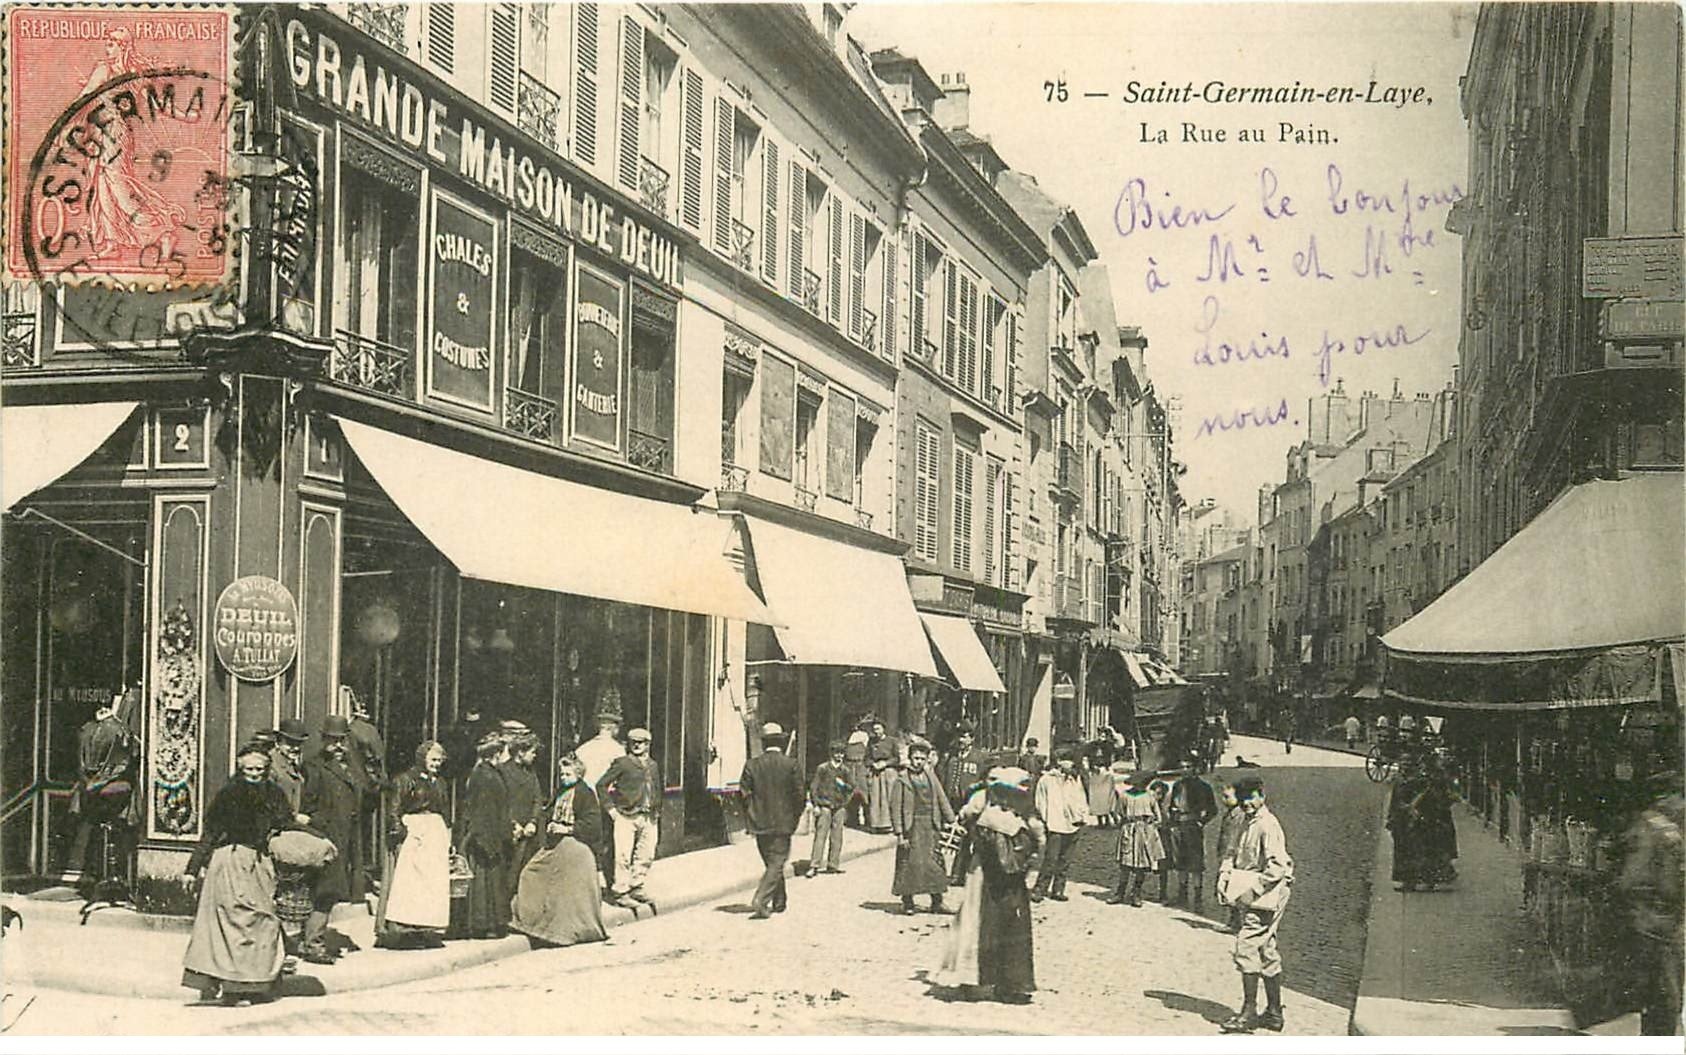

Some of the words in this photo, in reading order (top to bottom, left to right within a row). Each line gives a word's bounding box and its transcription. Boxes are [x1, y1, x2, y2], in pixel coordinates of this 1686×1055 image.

[287, 19, 447, 163] GRANDE
[460, 118, 573, 234] MAISON
[581, 192, 615, 254] DE
[620, 215, 684, 290] DEUIL
[1114, 178, 1236, 236] Bien
[1260, 167, 1298, 219] le
[436, 233, 492, 276] CHALES
[457, 292, 470, 315] &
[1313, 325, 1431, 387] pour
[174, 423, 190, 451] 2
[1194, 399, 1300, 440] nous.
[220, 607, 292, 626] DEUIL
